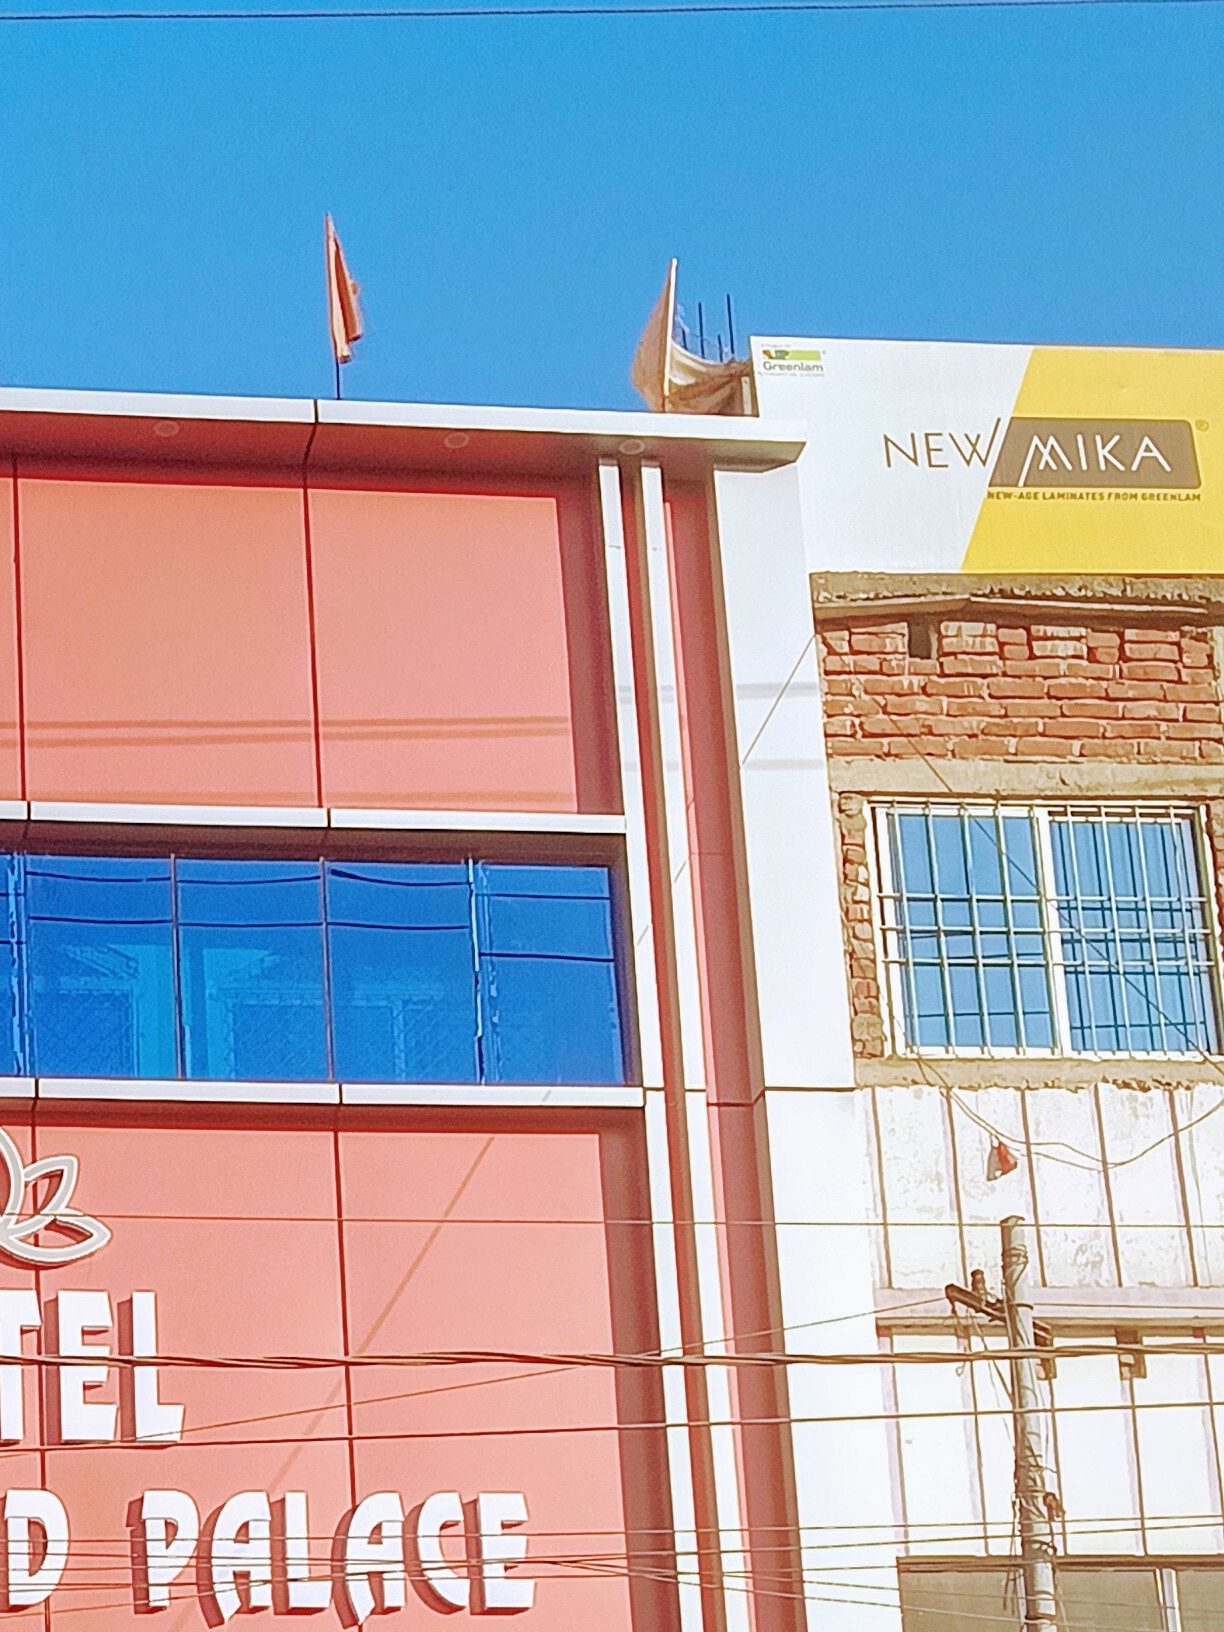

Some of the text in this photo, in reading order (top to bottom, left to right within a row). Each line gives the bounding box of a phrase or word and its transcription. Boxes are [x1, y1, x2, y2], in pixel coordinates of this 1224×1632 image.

[763, 361, 824, 371] Greenlam
[883, 417, 1172, 487] NEW MIKA
[1042, 491, 1105, 501] LAMINATES
[1107, 491, 1138, 501] FROM
[1141, 492, 1202, 502] GREENLAM
[138, 1488, 536, 1626] PALACE
